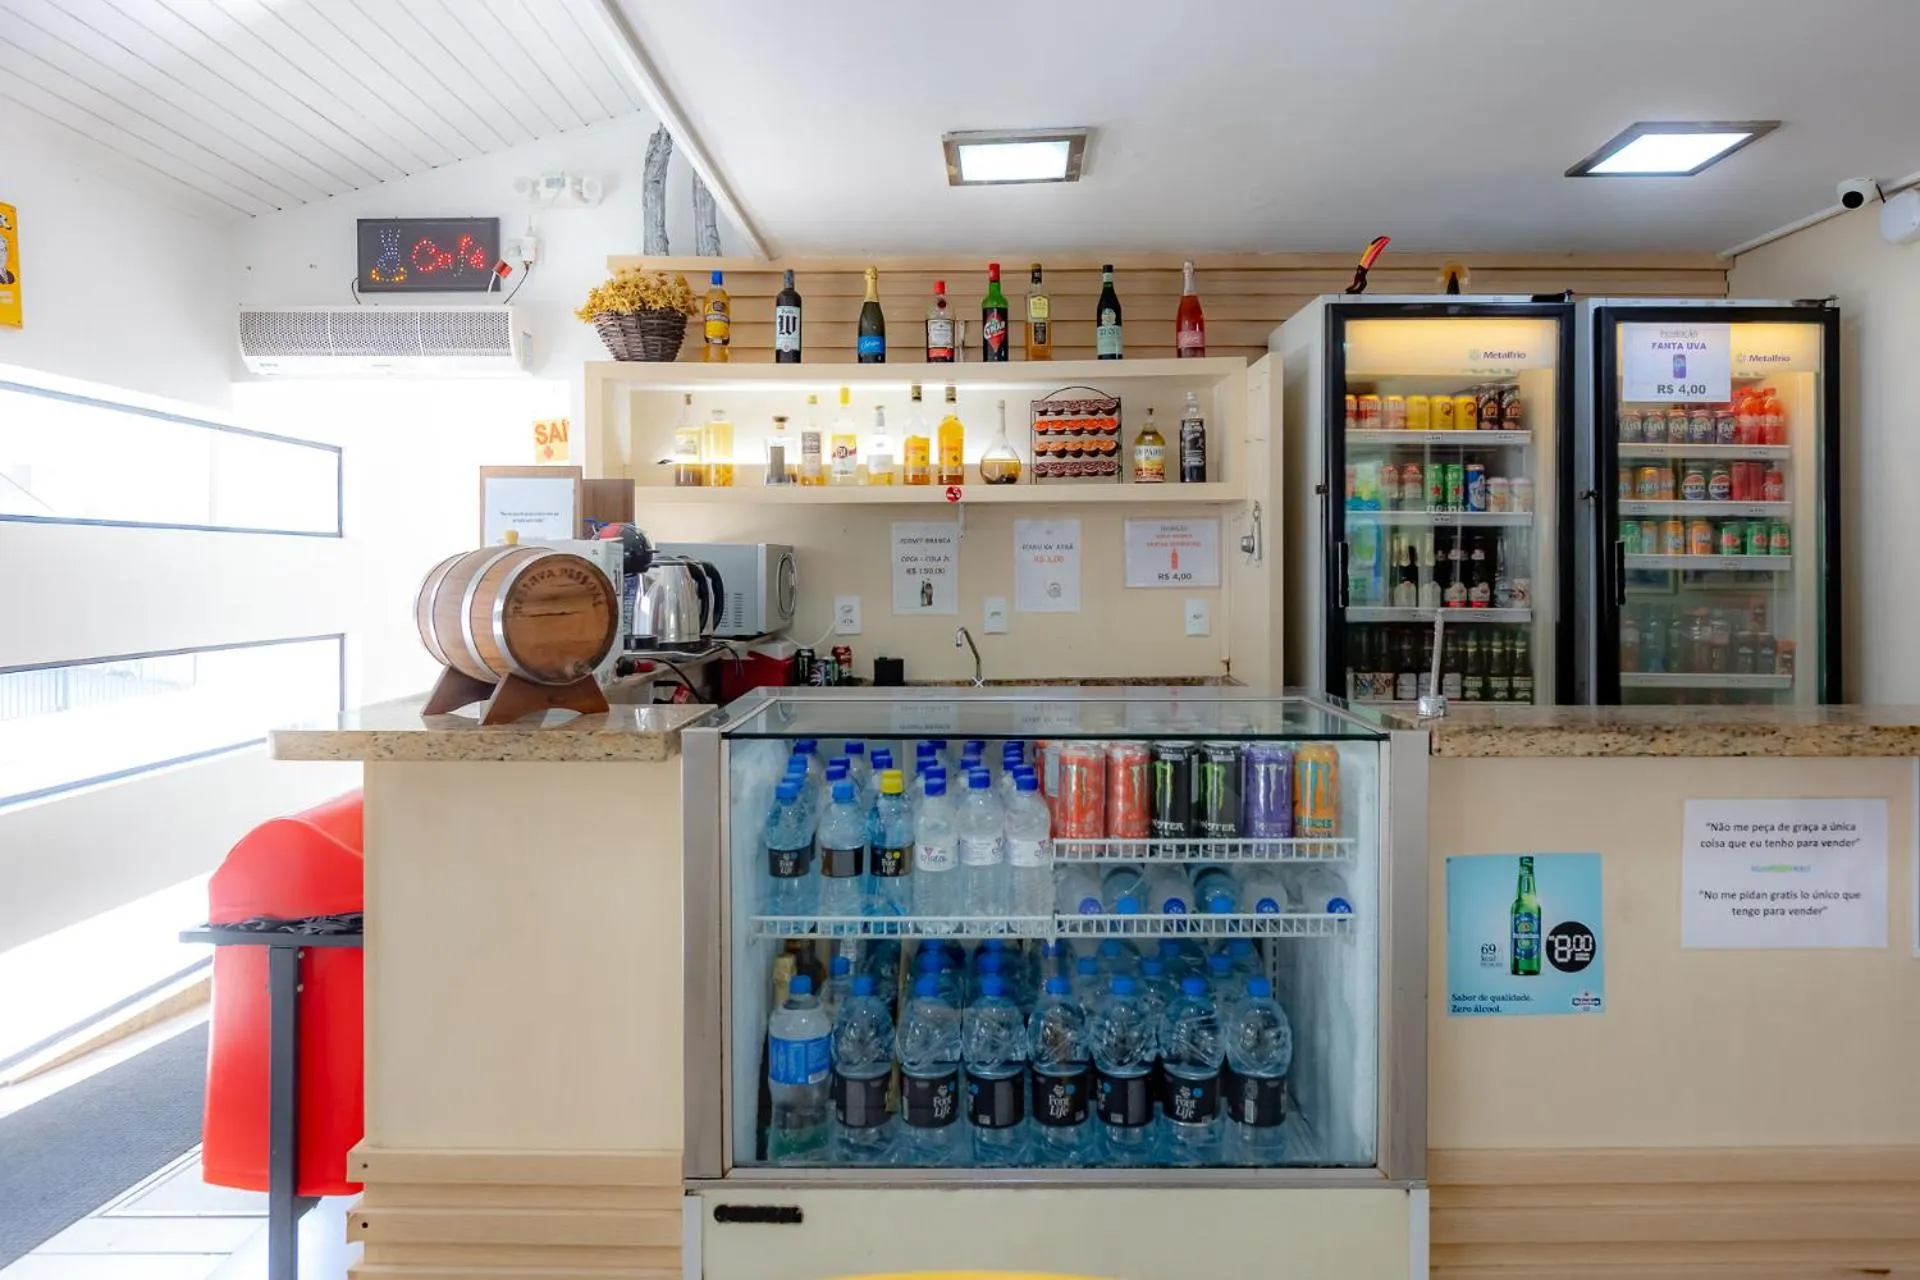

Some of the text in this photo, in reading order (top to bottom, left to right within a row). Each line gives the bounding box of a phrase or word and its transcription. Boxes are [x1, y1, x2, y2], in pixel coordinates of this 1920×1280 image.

[1652, 342, 1707, 351] FANTA UVA
[1483, 351, 1527, 360] Metalfrio
[1749, 354, 1791, 363] Metalfrio
[1657, 384, 1706, 396] R$ 4,00
[1158, 572, 1192, 582] R$ 4,00
[1733, 824, 1749, 832] me
[1752, 824, 1774, 834] peça
[1777, 822, 1790, 832] de
[1792, 824, 1819, 834] graça
[1830, 821, 1856, 832] única
[1700, 838, 1725, 848] coisa
[1728, 840, 1747, 850] que
[1749, 840, 1762, 848] eu
[1764, 838, 1794, 848] tenho
[1796, 840, 1818, 850] para
[1720, 892, 1737, 900] me
[1739, 890, 1768, 902] pidan
[1770, 890, 1797, 902] gratis
[1800, 889, 1810, 900] lo
[1812, 889, 1840, 900] único
[1842, 892, 1862, 902] que
[1731, 906, 1760, 918] tengo
[1763, 908, 1785, 918] para
[1480, 943, 1497, 955] 69
[1451, 992, 1477, 1001] Sabor
[1479, 992, 1488, 1001] de
[1451, 1004, 1472, 1014] Zero
